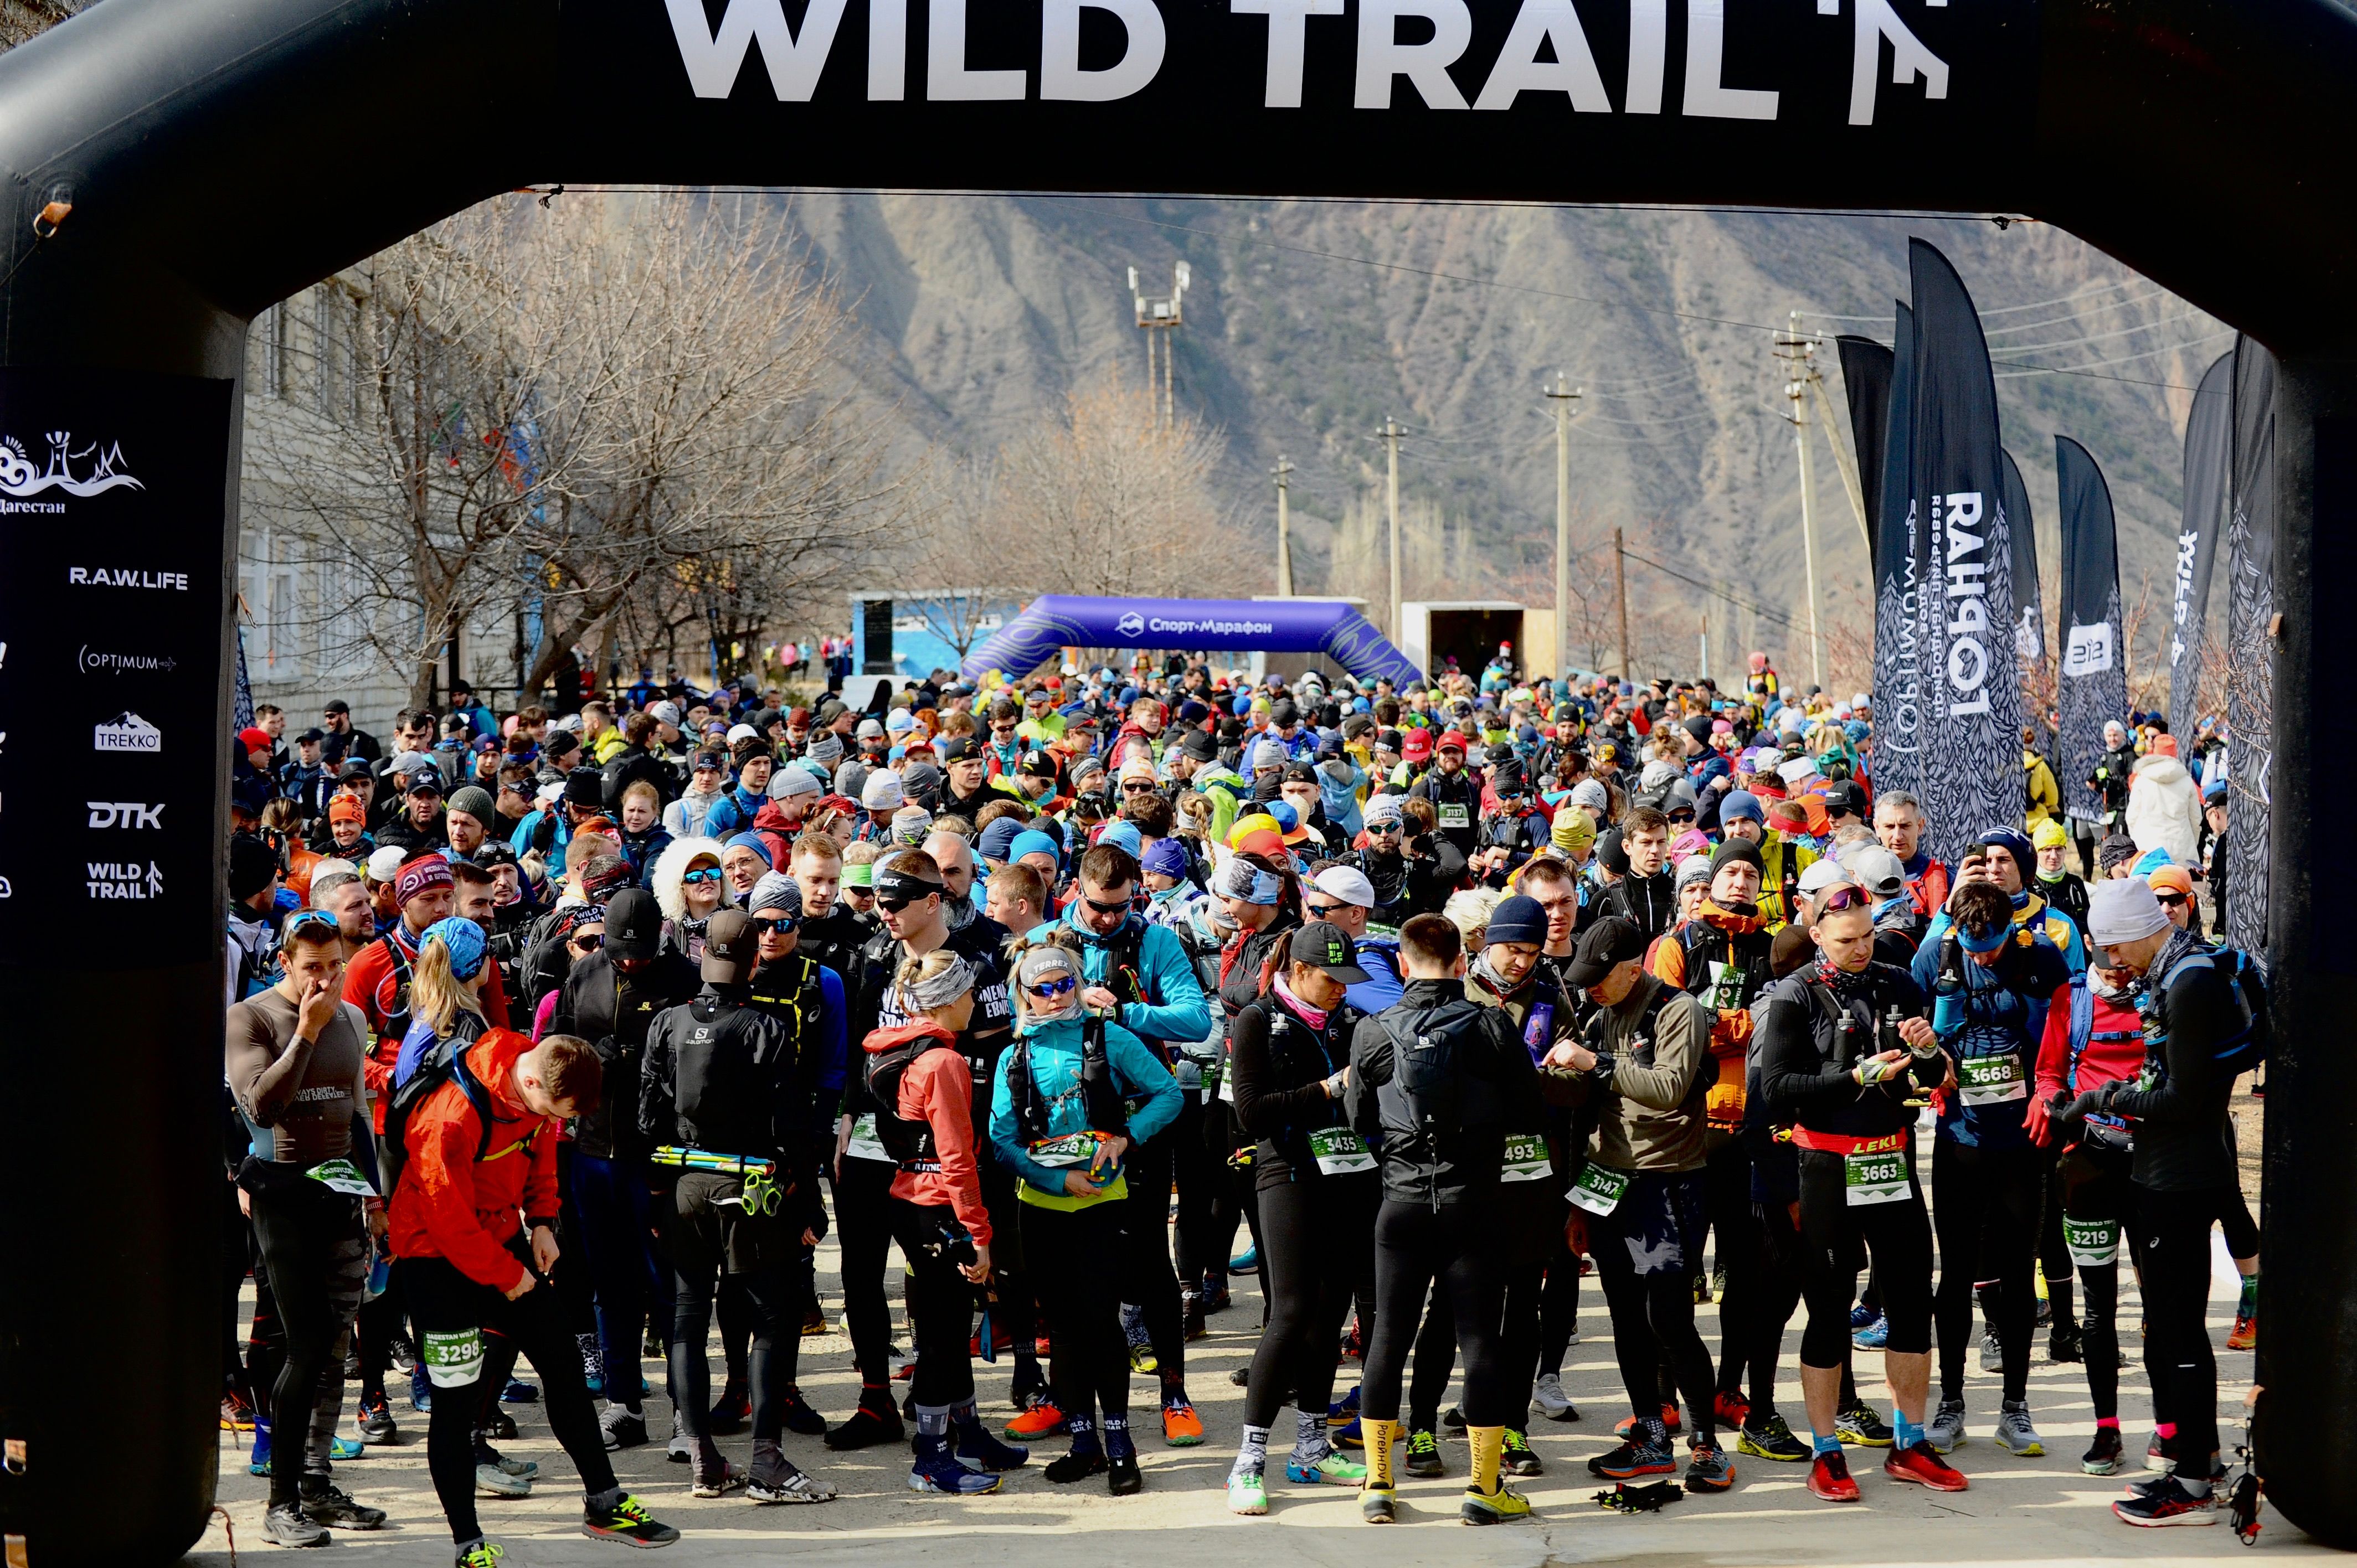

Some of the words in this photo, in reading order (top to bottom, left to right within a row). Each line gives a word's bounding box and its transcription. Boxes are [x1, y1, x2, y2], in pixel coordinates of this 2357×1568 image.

[665, 0, 1166, 101] WILD
[1231, 0, 1779, 120] TRAIL
[99, 733, 156, 749] TREKKO
[86, 802, 166, 829] DTK
[1446, 809, 1463, 817] 3137
[86, 863, 141, 880] WILD
[86, 881, 146, 899] TRAIL
[576, 907, 598, 919] WILD
[579, 914, 602, 925] TRAIL
[1033, 960, 1068, 973] TERREX
[1970, 1065, 2012, 1084] 3668
[1324, 1137, 1357, 1152] 3435
[1852, 1134, 1897, 1154] LEKI
[1860, 1163, 1897, 1182] 3663
[1589, 1174, 1620, 1194] 3147
[2072, 1230, 2108, 1245] 3219
[438, 1340, 480, 1363] 3298
